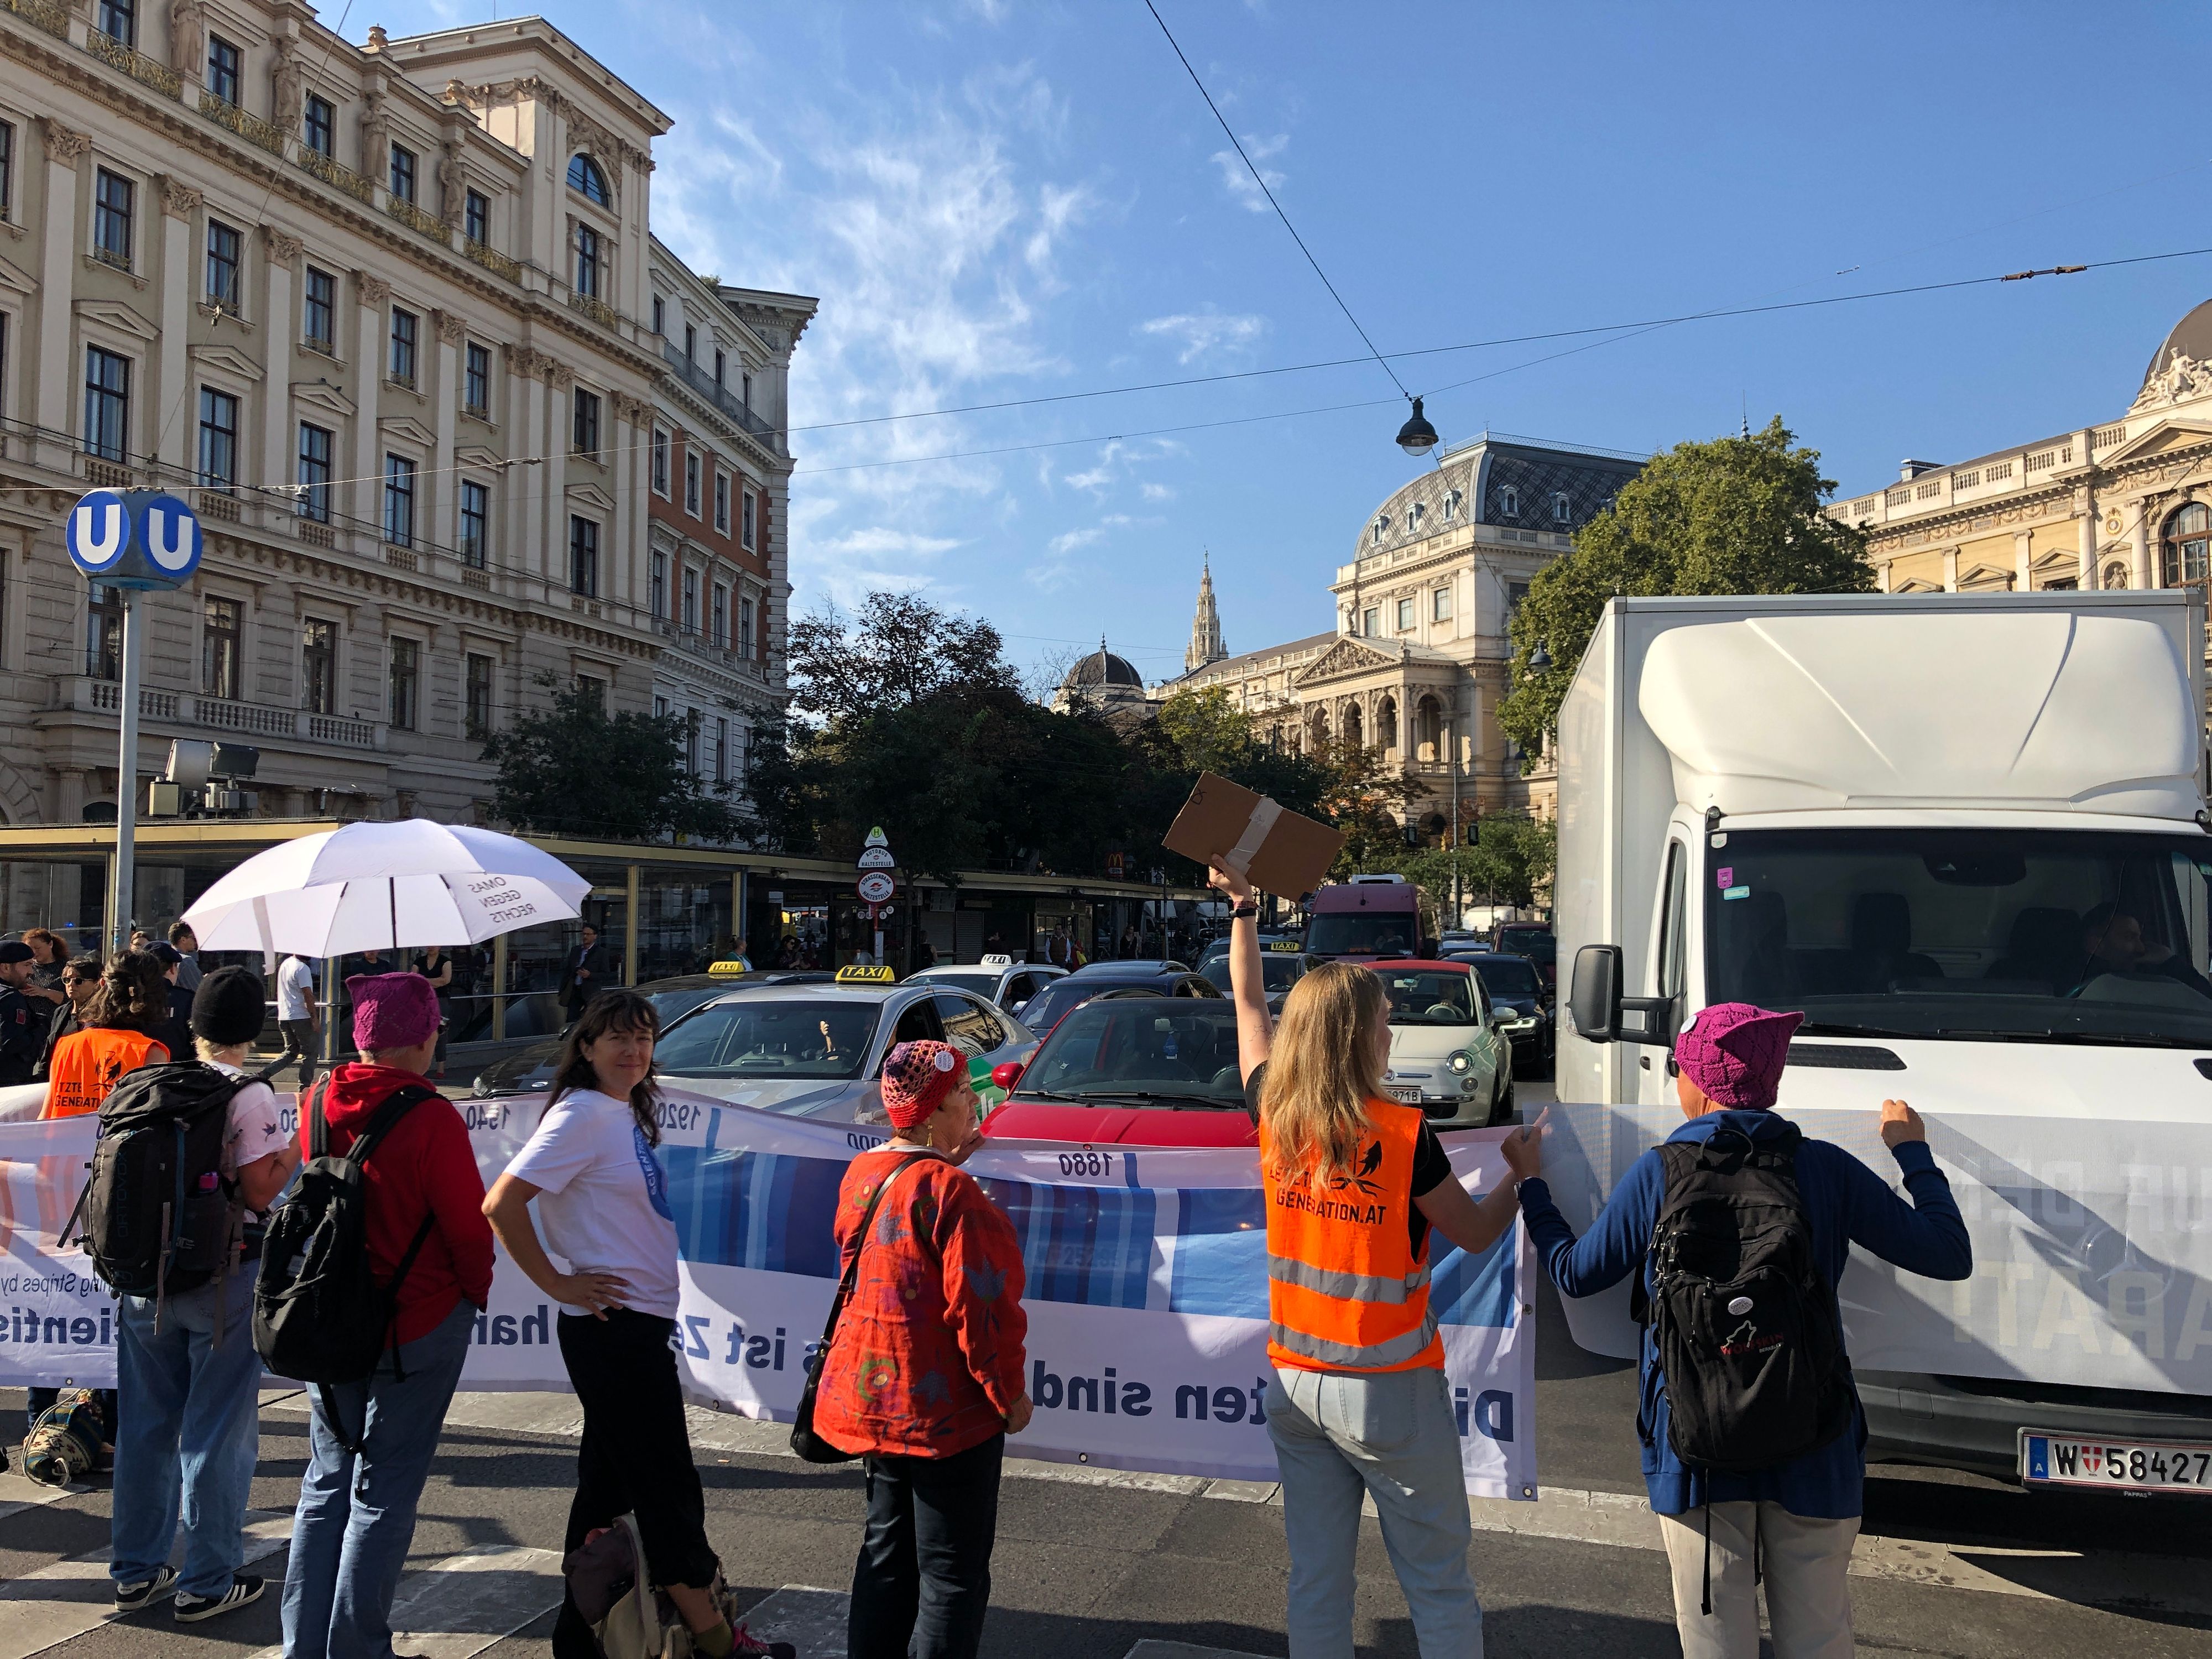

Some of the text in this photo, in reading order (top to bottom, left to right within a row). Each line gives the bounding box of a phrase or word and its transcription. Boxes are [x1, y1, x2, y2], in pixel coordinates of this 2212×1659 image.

[77, 504, 120, 564] U
[149, 508, 192, 570] U
[866, 849, 888, 857] AUTOBUS
[861, 873, 891, 886] STRASSENBAHN
[862, 890, 890, 900] HALTESTELLE
[846, 967, 885, 977] TAXI
[59, 1082, 82, 1093] TZTE
[116, 1150, 128, 1238] ORTOVOX
[1276, 1187, 1387, 1225] GENERATION.AT
[2035, 1444, 2211, 1484] A W 58427
